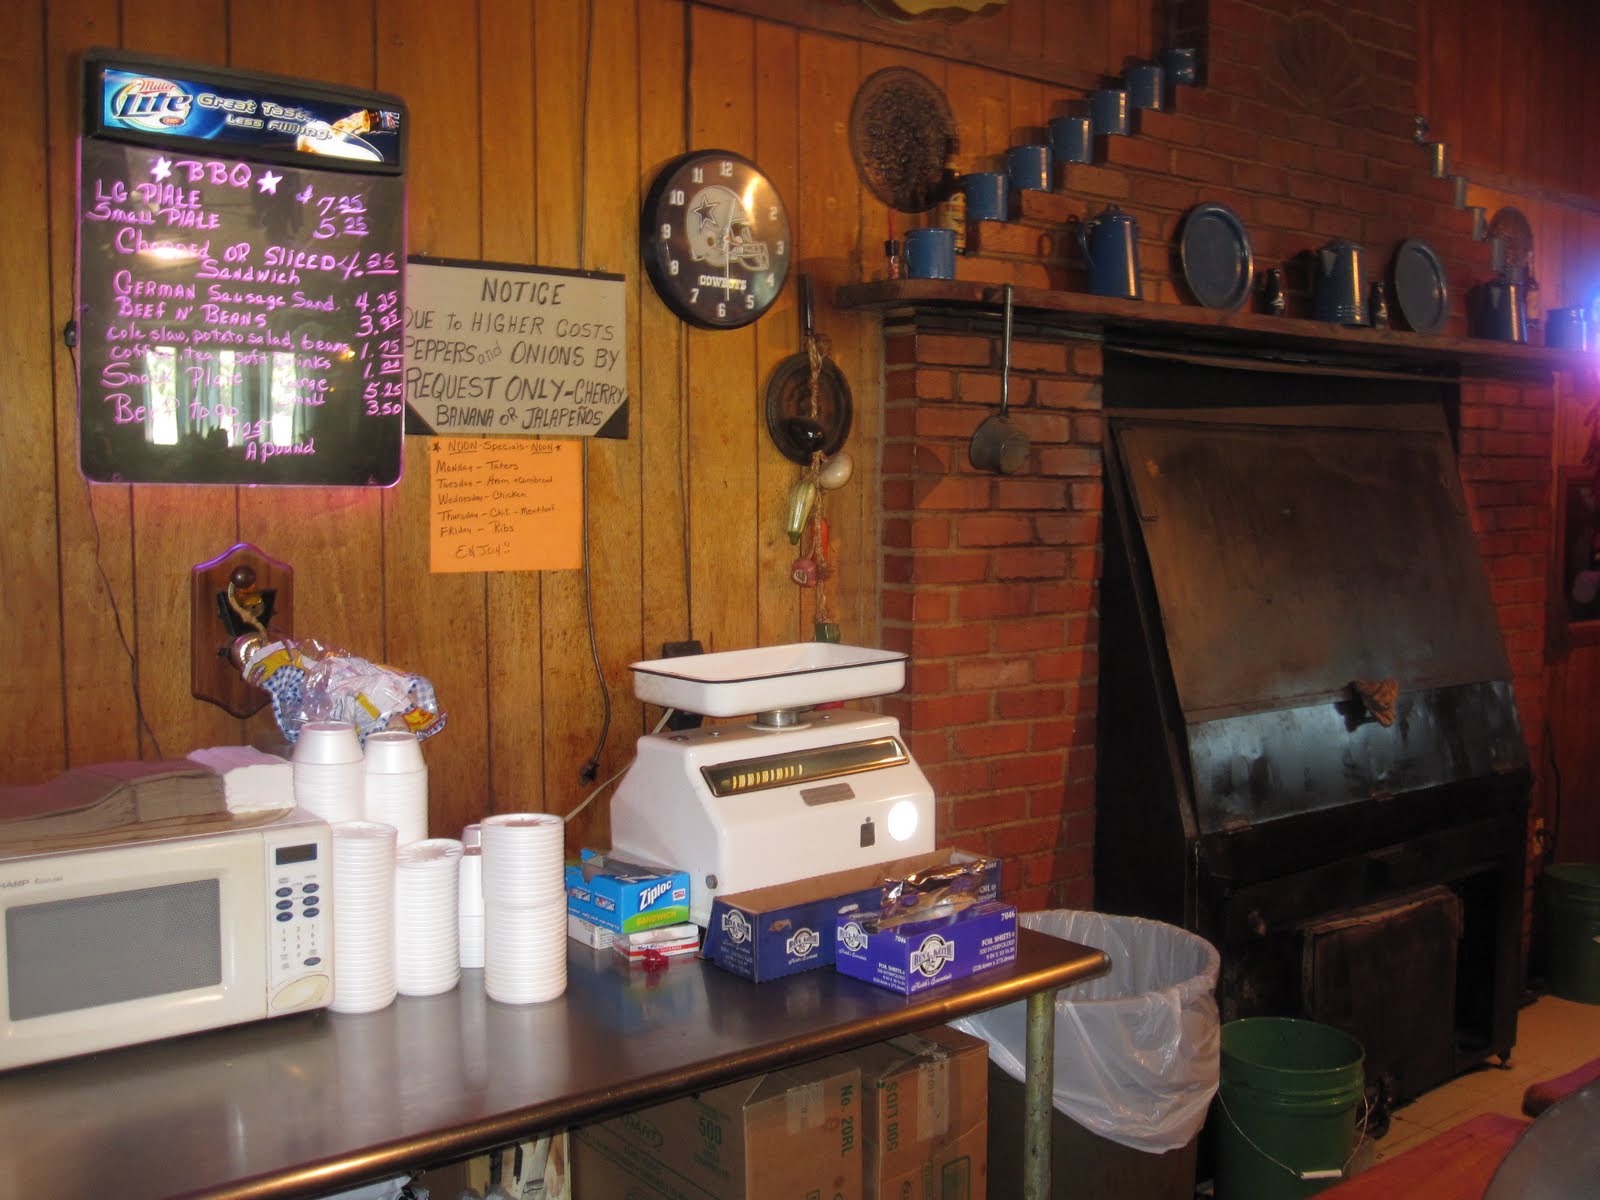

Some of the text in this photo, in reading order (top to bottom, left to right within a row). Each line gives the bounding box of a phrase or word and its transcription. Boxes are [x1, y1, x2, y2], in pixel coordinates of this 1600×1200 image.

[133, 78, 176, 92] Miller
[113, 92, 193, 119] Lite
[197, 93, 257, 114] Great
[225, 113, 264, 129] Less
[175, 161, 251, 188] BBQ
[692, 168, 703, 183] 11
[720, 162, 733, 177] 12
[95, 178, 128, 203] LG
[670, 190, 684, 205] 10
[85, 201, 156, 225] Small
[769, 206, 777, 221] 2
[661, 224, 671, 239] 9
[195, 259, 300, 285] Sandwich
[669, 260, 679, 275] 8
[700, 275, 747, 290] COWBOYS
[767, 273, 774, 287] 4
[113, 270, 197, 299] GERMAN
[208, 284, 286, 311] Sausage
[481, 277, 565, 305] NOTICE
[690, 288, 699, 303] 7
[718, 303, 726, 317] 6
[747, 295, 755, 310] 5
[200, 303, 267, 328] BEANS
[405, 306, 435, 329] DUE
[471, 311, 545, 335] HIGHER
[556, 318, 614, 341] COSTS
[191, 329, 244, 345] potato
[405, 335, 477, 364] PEPPERS
[511, 340, 584, 366] ONIONS
[595, 347, 620, 372] BY
[405, 367, 502, 401] REQUEST
[436, 404, 494, 427] BANANA
[436, 460, 473, 474] Monday
[488, 521, 514, 533] Ribs
[639, 880, 672, 912] Ziploc
[636, 910, 677, 926] SANDWICH
